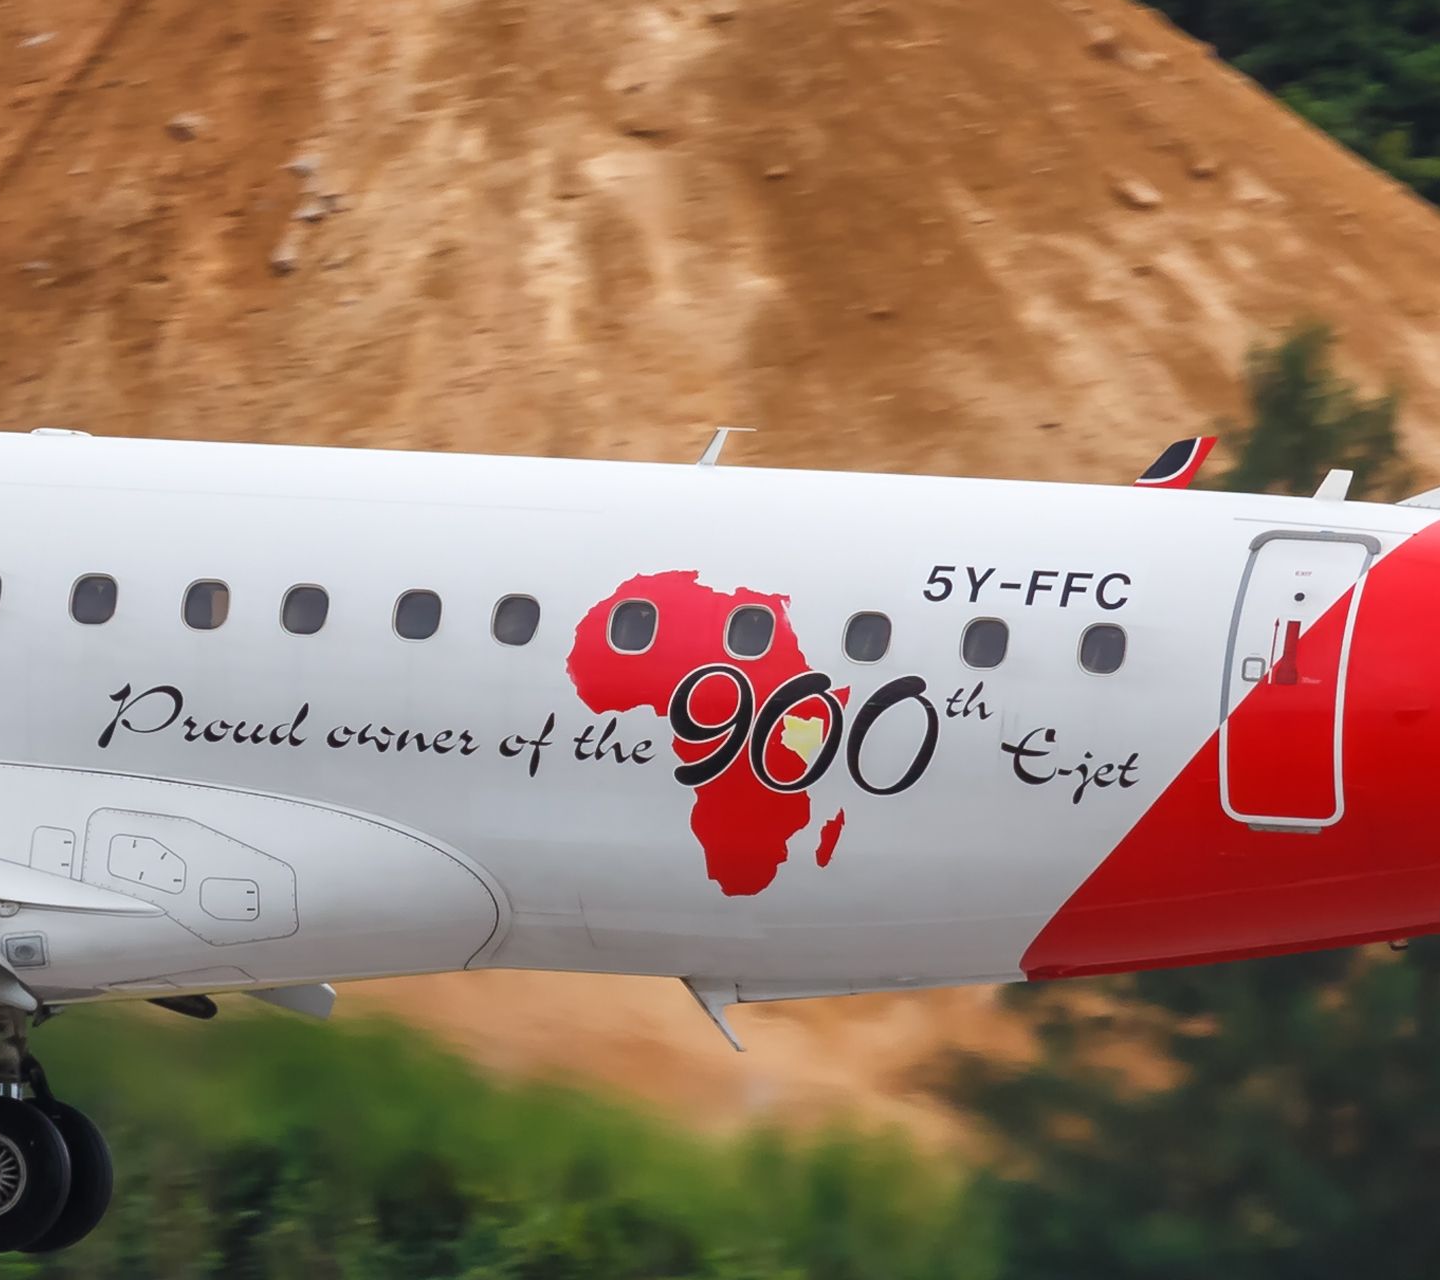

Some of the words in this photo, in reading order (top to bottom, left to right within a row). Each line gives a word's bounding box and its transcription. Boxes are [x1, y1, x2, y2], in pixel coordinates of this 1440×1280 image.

[923, 565, 1131, 610] 5Y-FFC
[99, 683, 309, 749] Proud
[326, 723, 479, 756] owner
[499, 712, 555, 778] of
[573, 725, 654, 766] the
[669, 664, 939, 796] 900
[946, 681, 992, 722] th
[1001, 728, 1140, 792] E-jet
